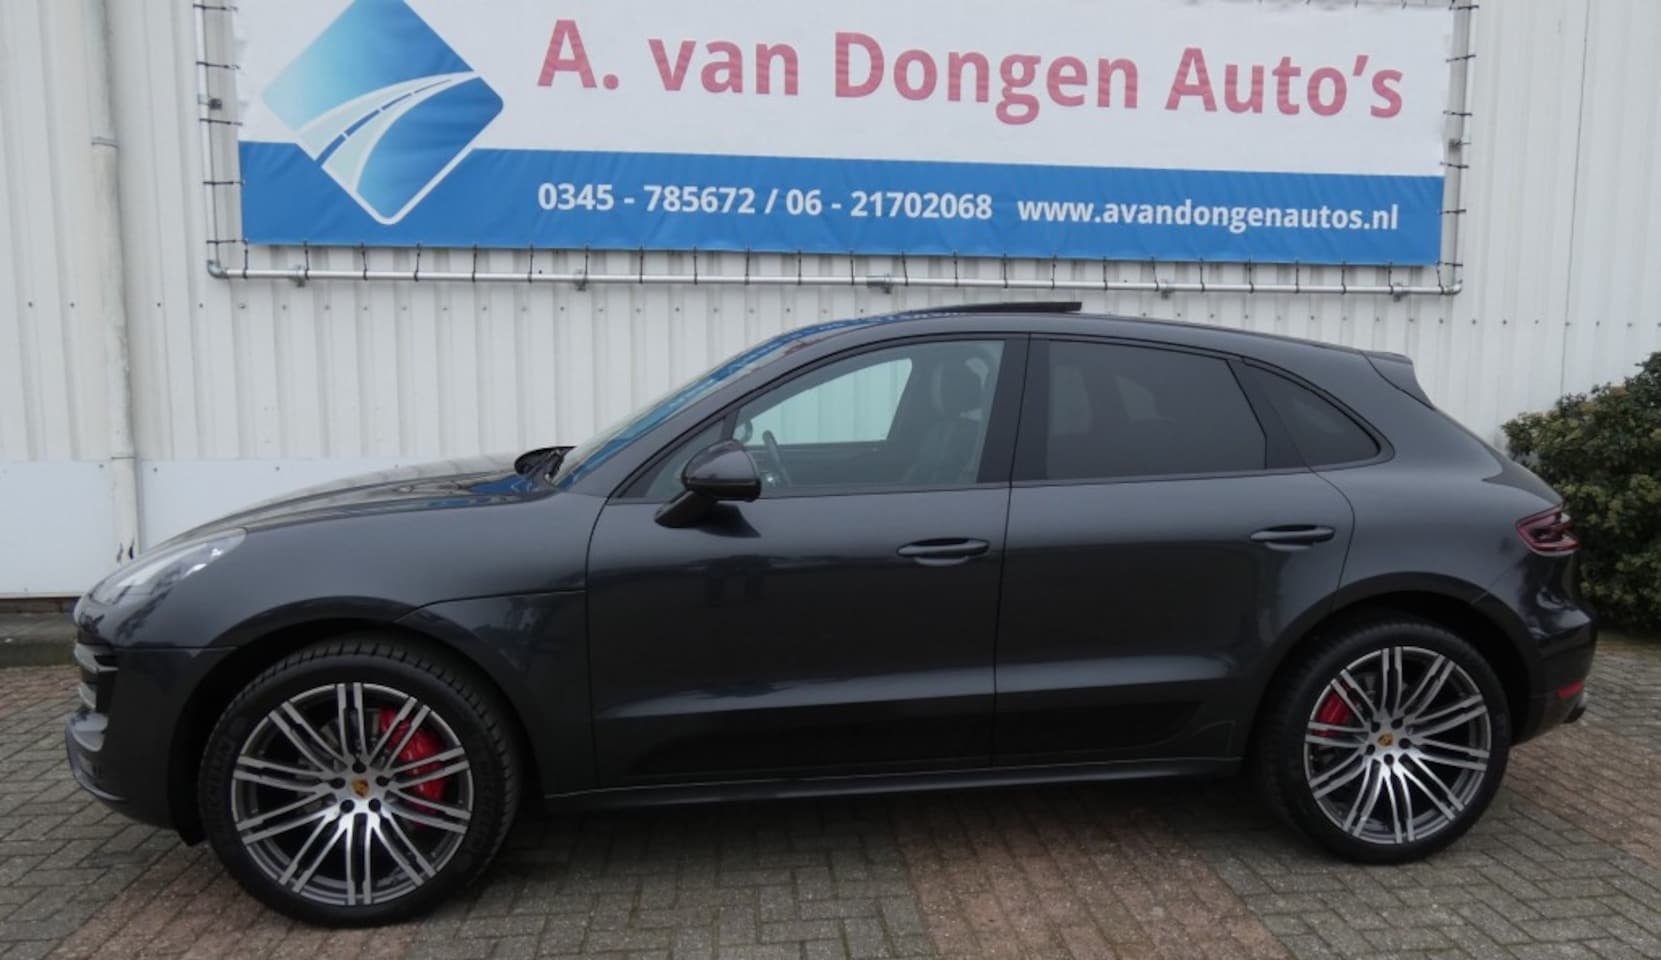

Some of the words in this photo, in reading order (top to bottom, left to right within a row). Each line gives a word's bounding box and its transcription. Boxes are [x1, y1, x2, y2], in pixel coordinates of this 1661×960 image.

[537, 19, 619, 89] A.
[648, 39, 799, 95] van
[834, 31, 1138, 125] Dongen
[1165, 47, 1403, 118] Auto's
[538, 183, 614, 210] 0345
[644, 185, 755, 213] 785672
[765, 189, 778, 214] /
[786, 189, 822, 215] 06
[851, 191, 992, 219] 21702068
[1018, 199, 1399, 234] www.avandongenautos.nl
